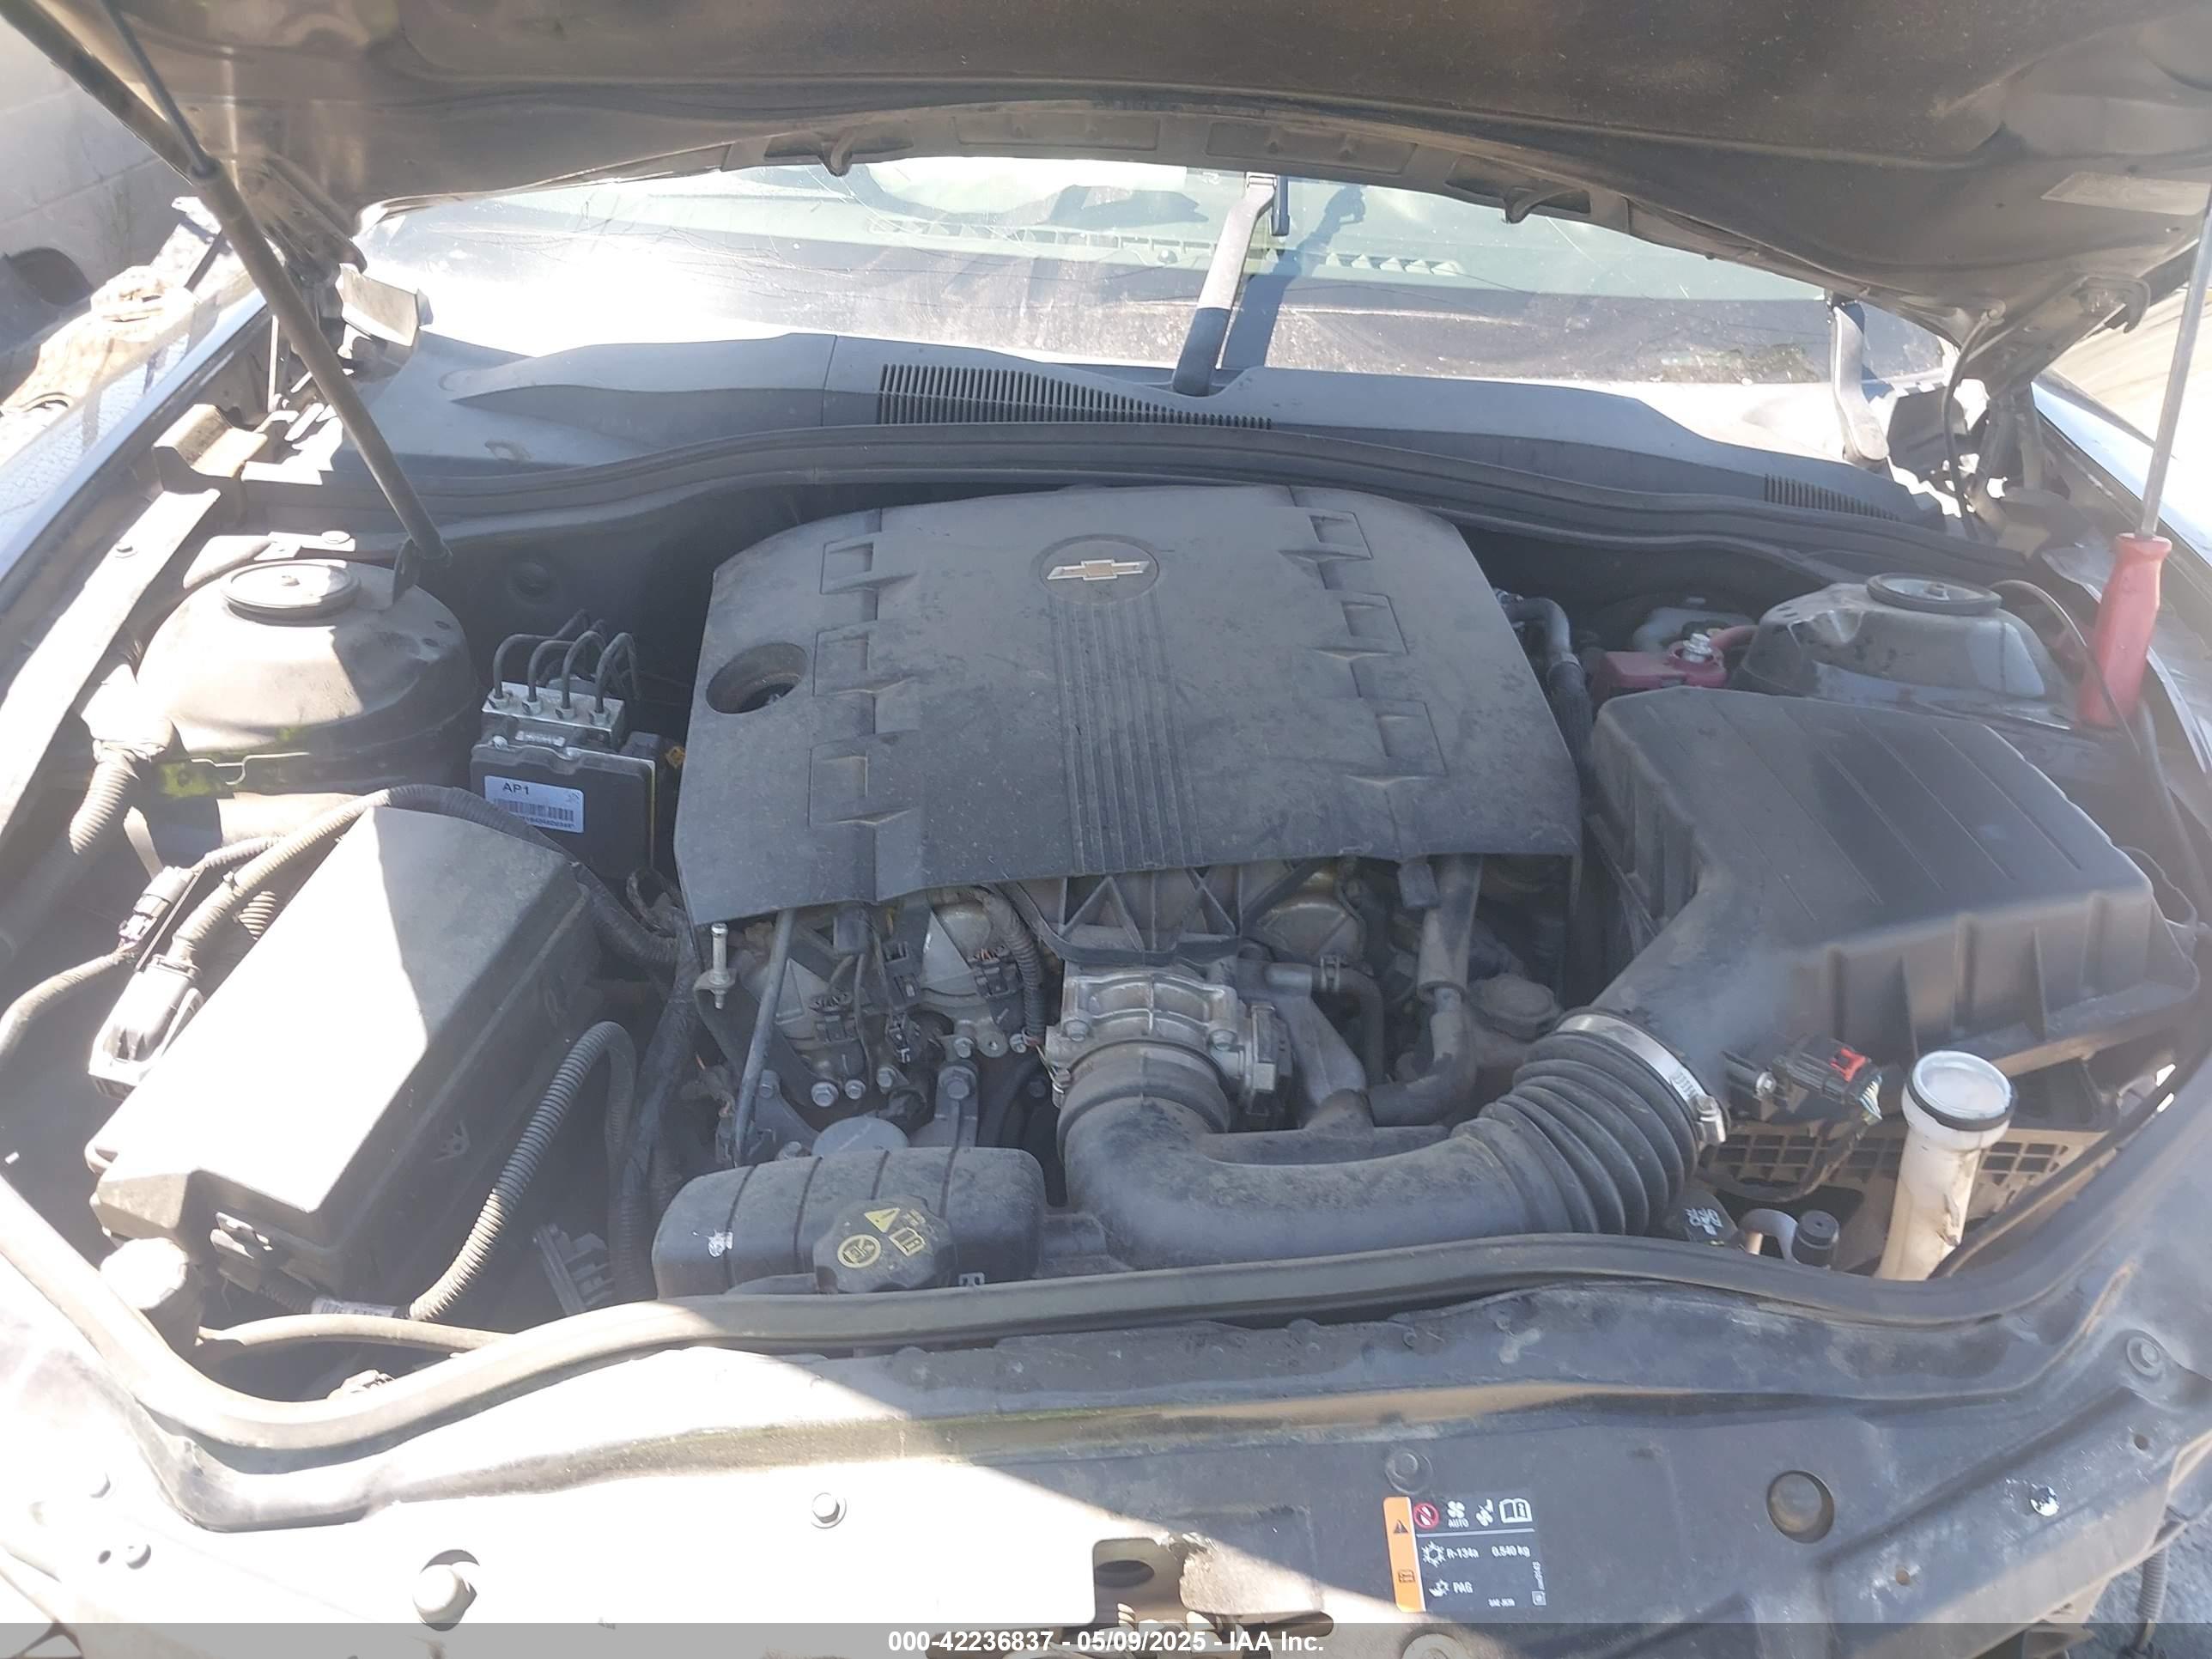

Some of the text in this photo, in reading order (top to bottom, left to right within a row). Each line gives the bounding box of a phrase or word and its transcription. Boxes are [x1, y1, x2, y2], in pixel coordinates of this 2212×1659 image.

[502, 782, 530, 795] AP1
[1447, 1517, 1470, 1528] AUTO
[1517, 1545, 1531, 1558] kg
[1452, 1581, 1474, 1594] PAG
